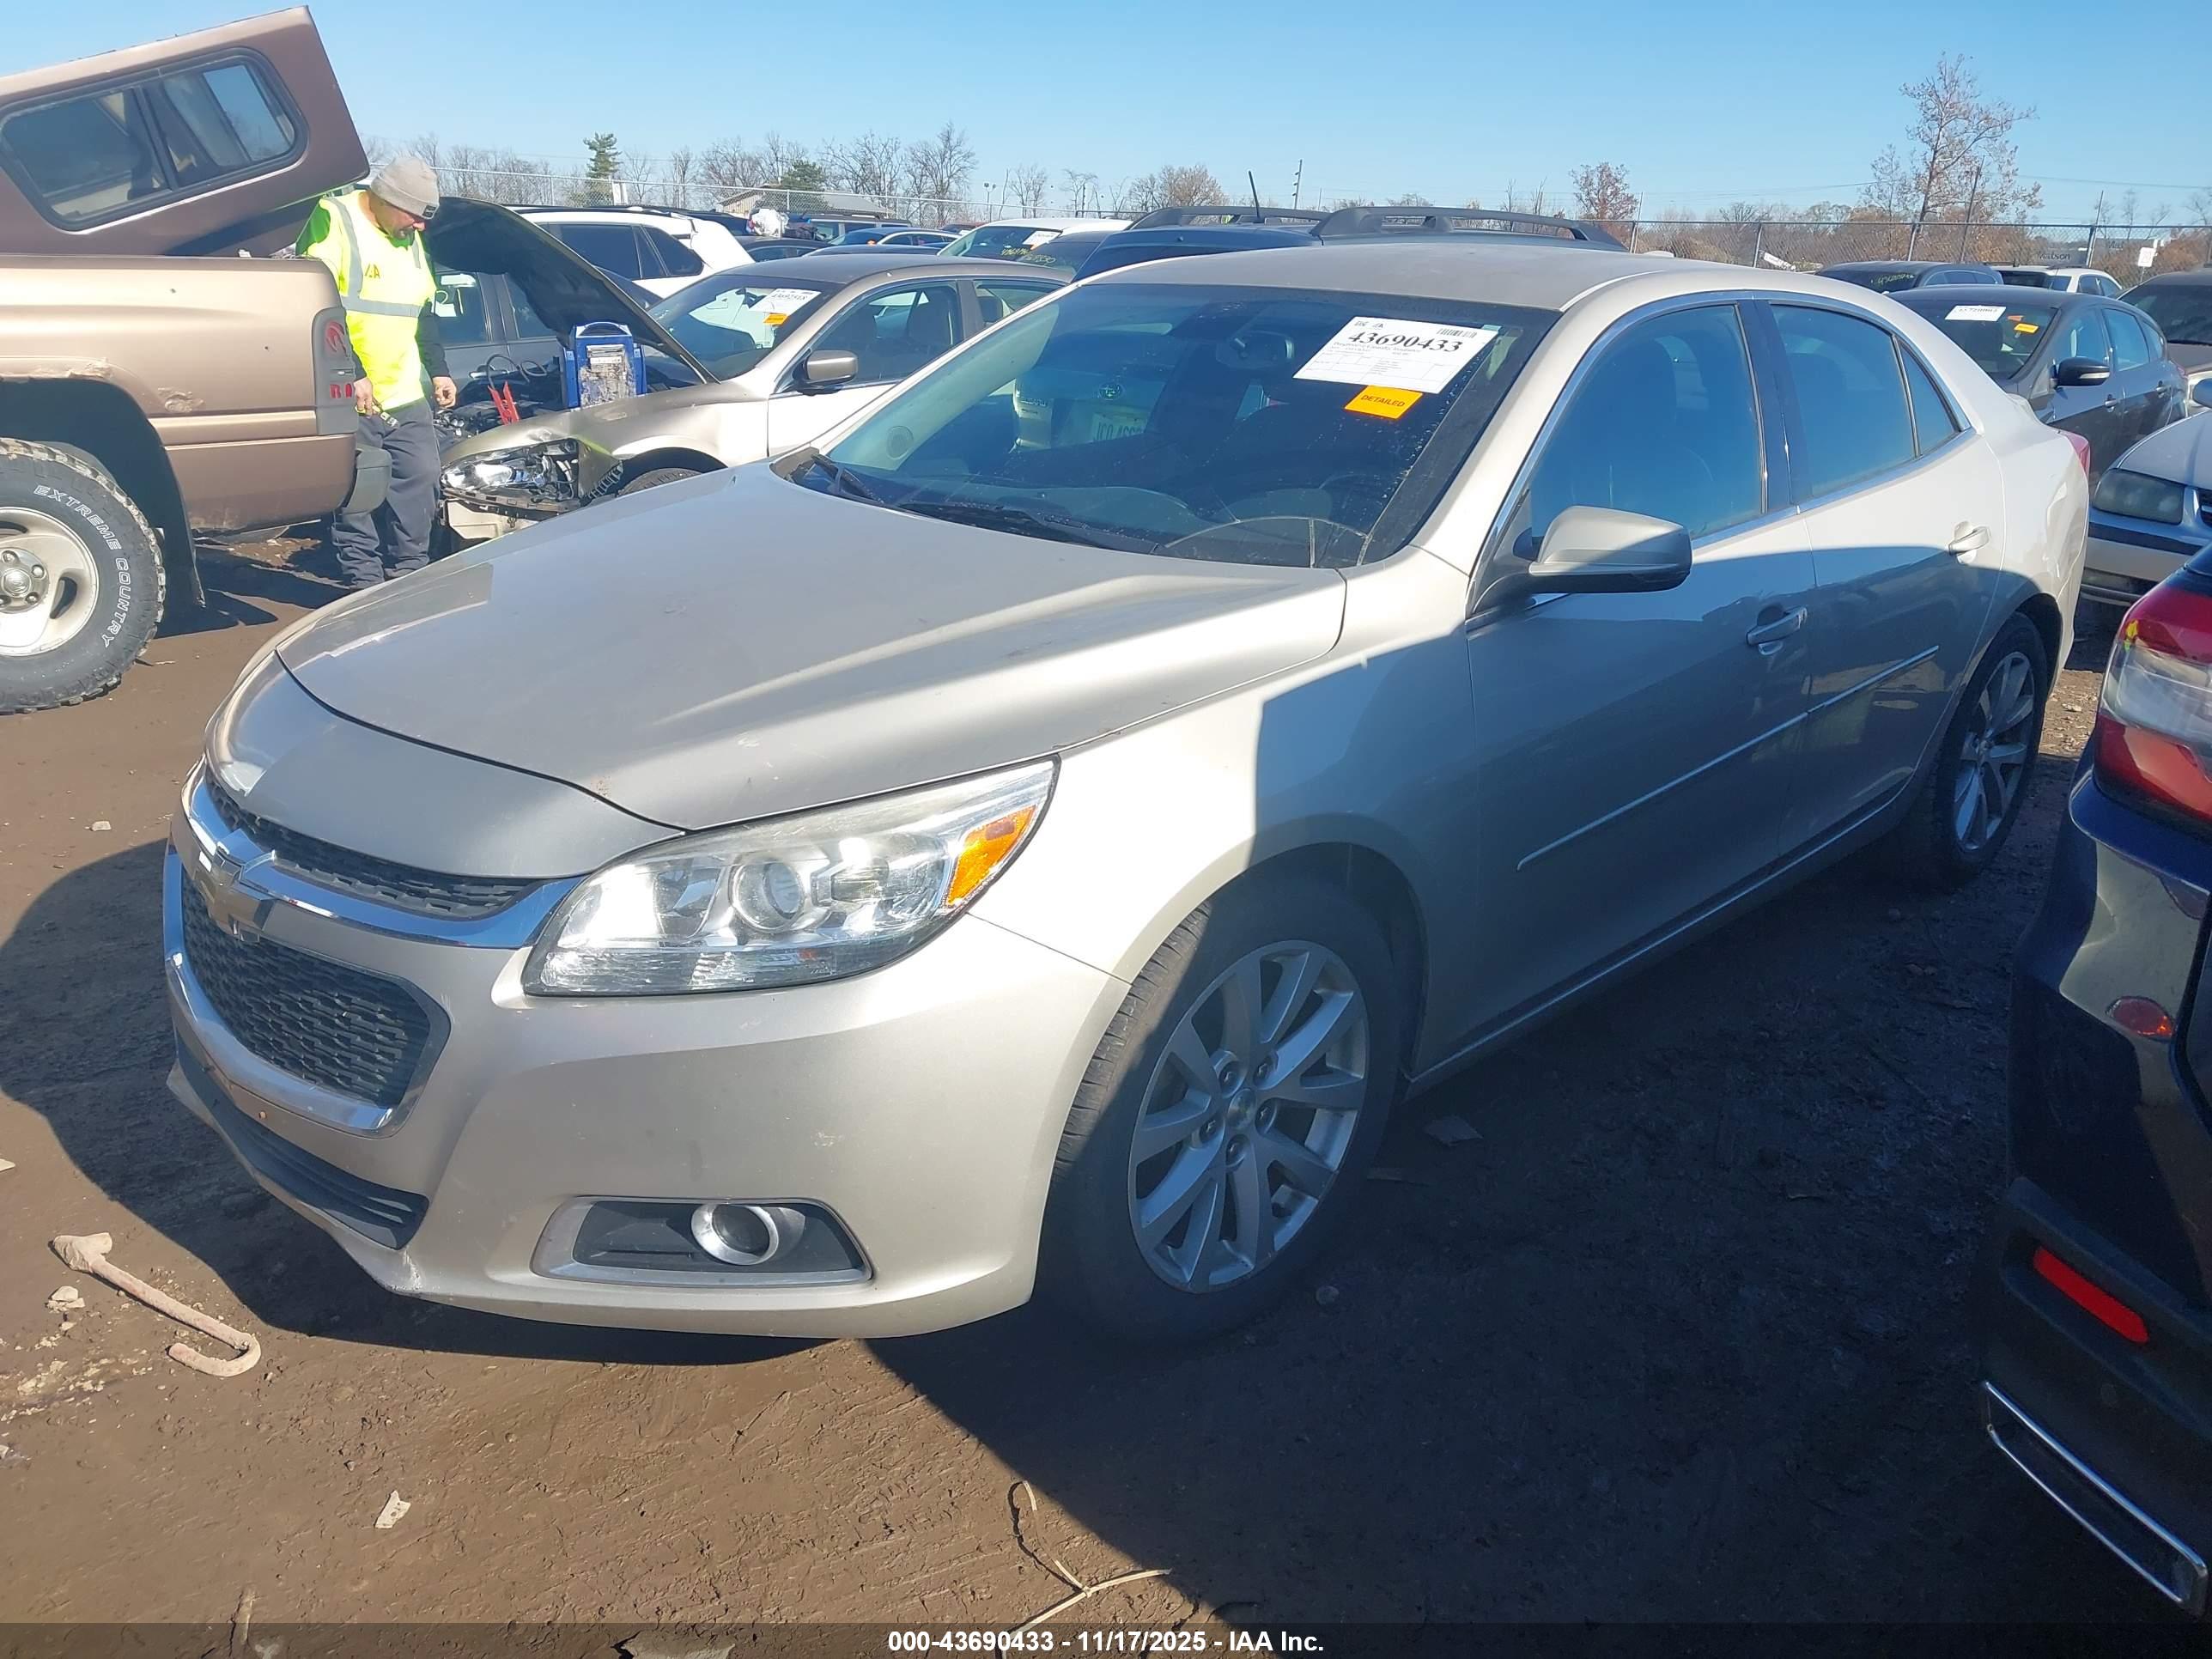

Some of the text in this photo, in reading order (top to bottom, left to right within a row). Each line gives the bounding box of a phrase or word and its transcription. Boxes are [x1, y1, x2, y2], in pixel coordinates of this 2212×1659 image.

[1348, 331, 1463, 353] 43690433
[1360, 394, 1406, 408] DETAILED
[33, 484, 131, 648] EXTREME COUNTRY
